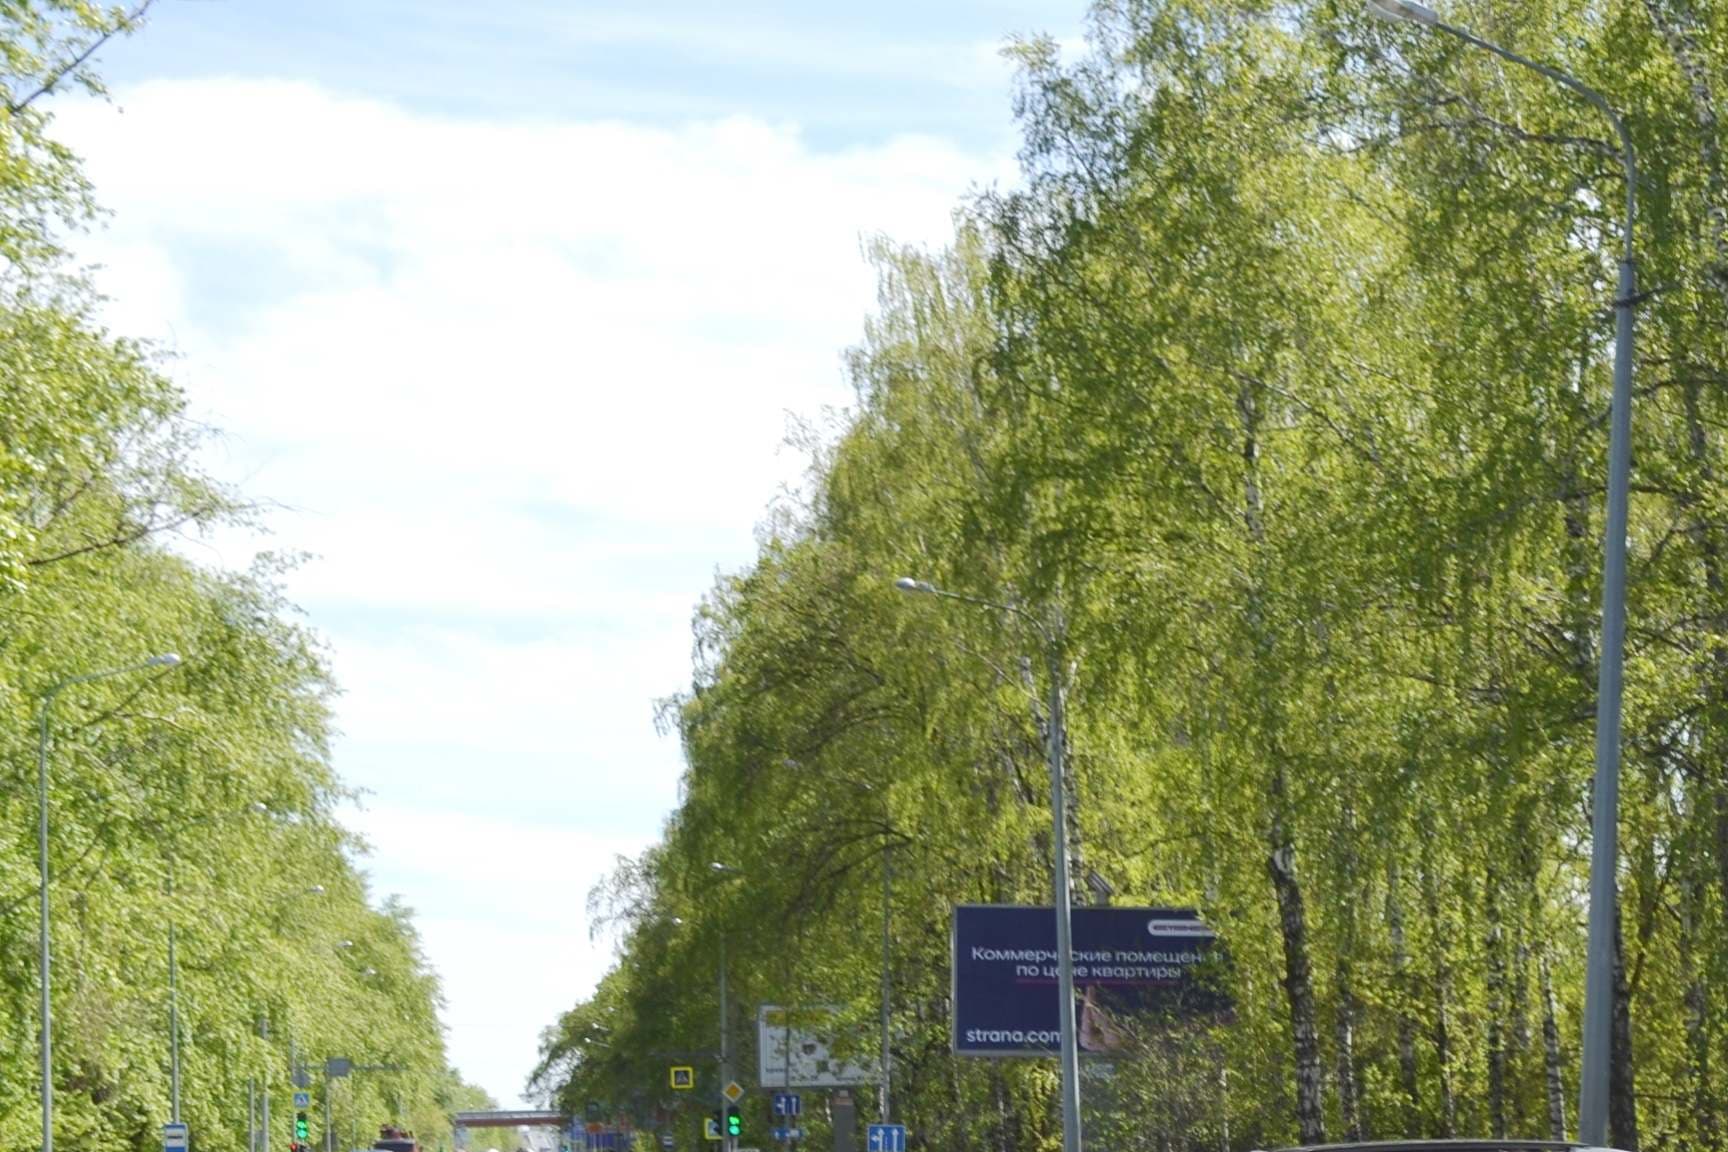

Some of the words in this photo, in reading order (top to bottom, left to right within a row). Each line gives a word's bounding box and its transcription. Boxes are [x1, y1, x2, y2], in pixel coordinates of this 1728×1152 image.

[971, 946, 1112, 966] Коммерчские
[1016, 965, 1040, 977] по
[1092, 966, 1182, 981] квартиры
